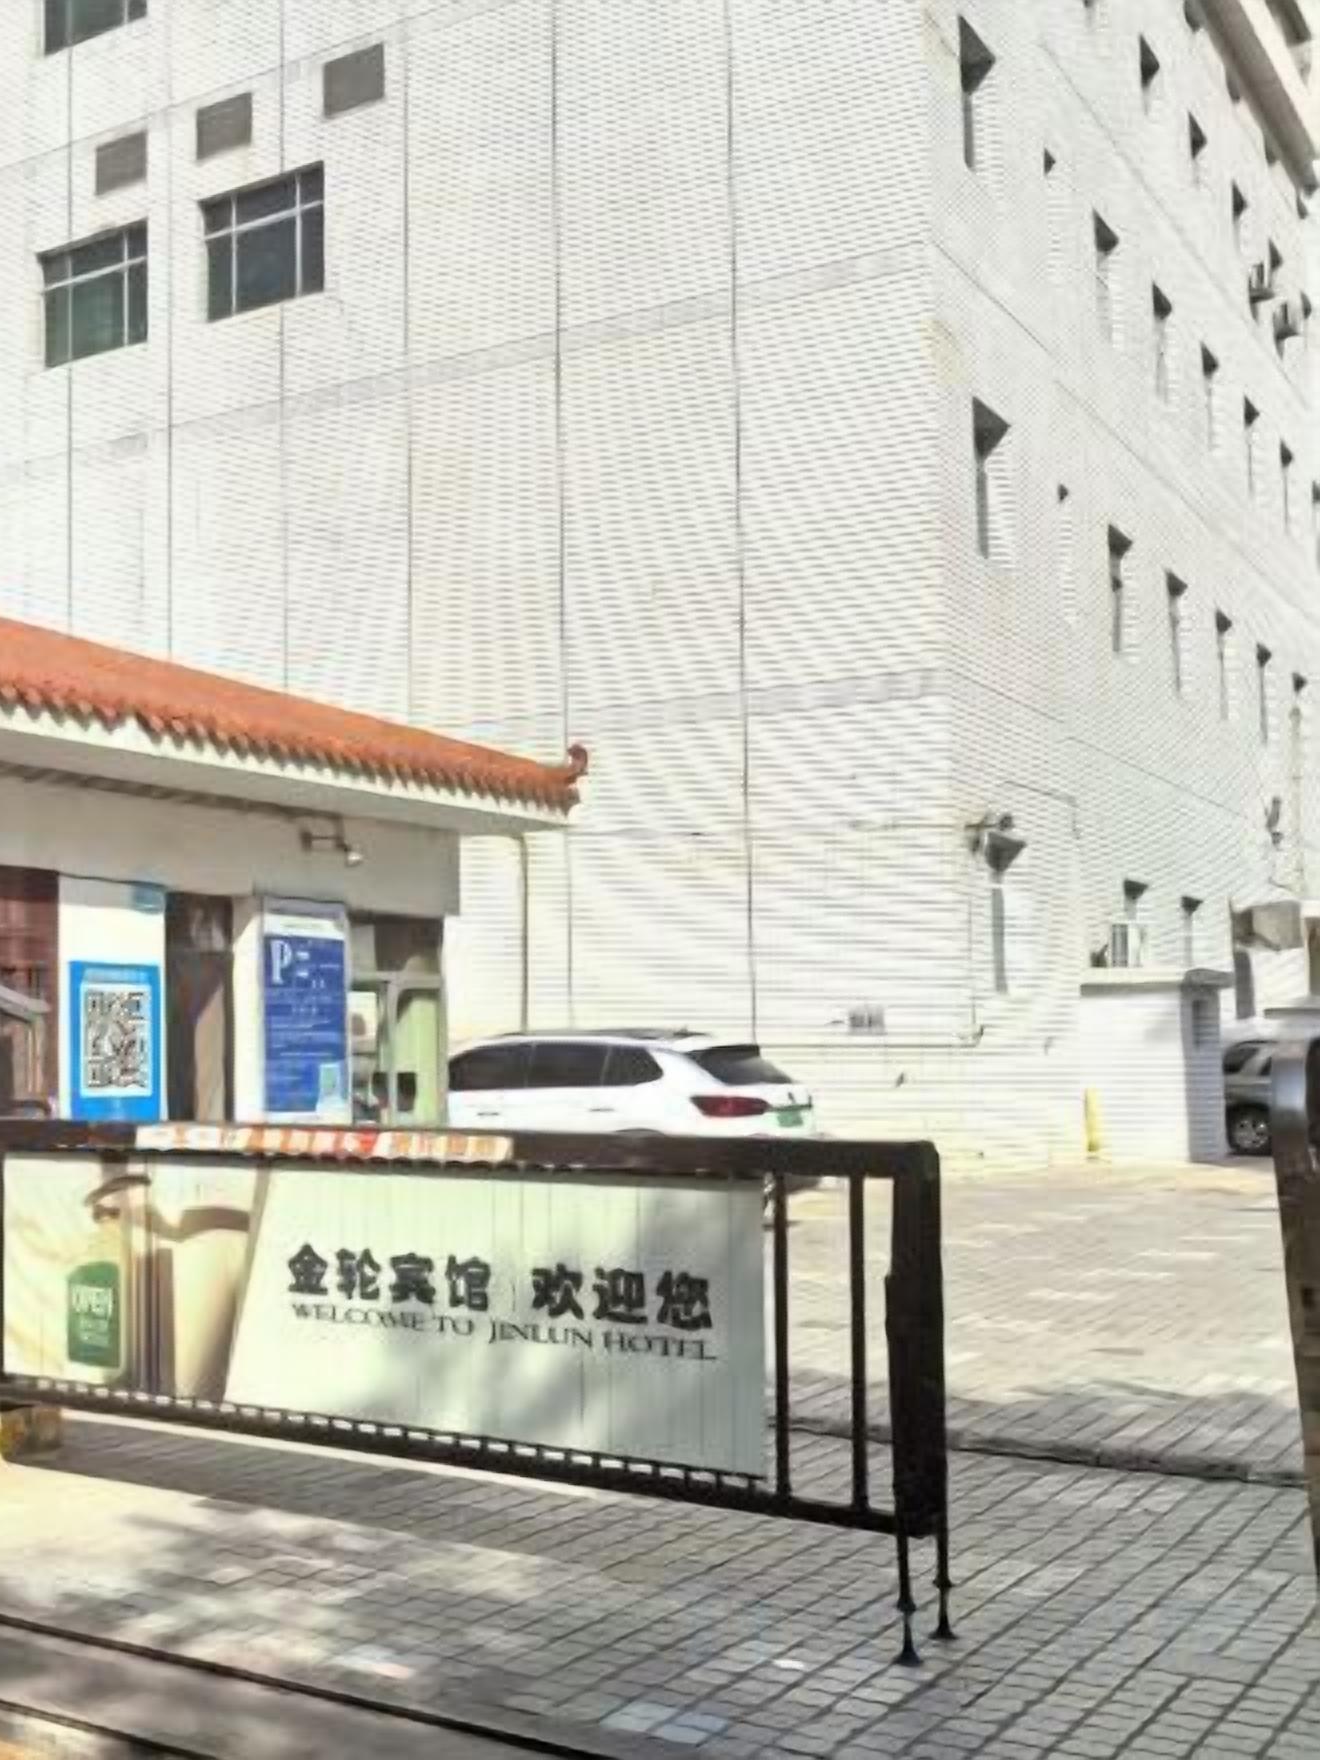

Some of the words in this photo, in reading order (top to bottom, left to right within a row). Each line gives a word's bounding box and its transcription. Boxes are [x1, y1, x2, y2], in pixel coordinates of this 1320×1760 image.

[270, 939, 292, 985] P
[288, 1242, 491, 1312] 金轮宾馆
[532, 1262, 712, 1331] 欢迎您
[292, 1303, 426, 1332] WELCOME
[432, 1314, 475, 1336] TO
[488, 1318, 593, 1348] JINLUN
[603, 1330, 717, 1360] HOTEL
